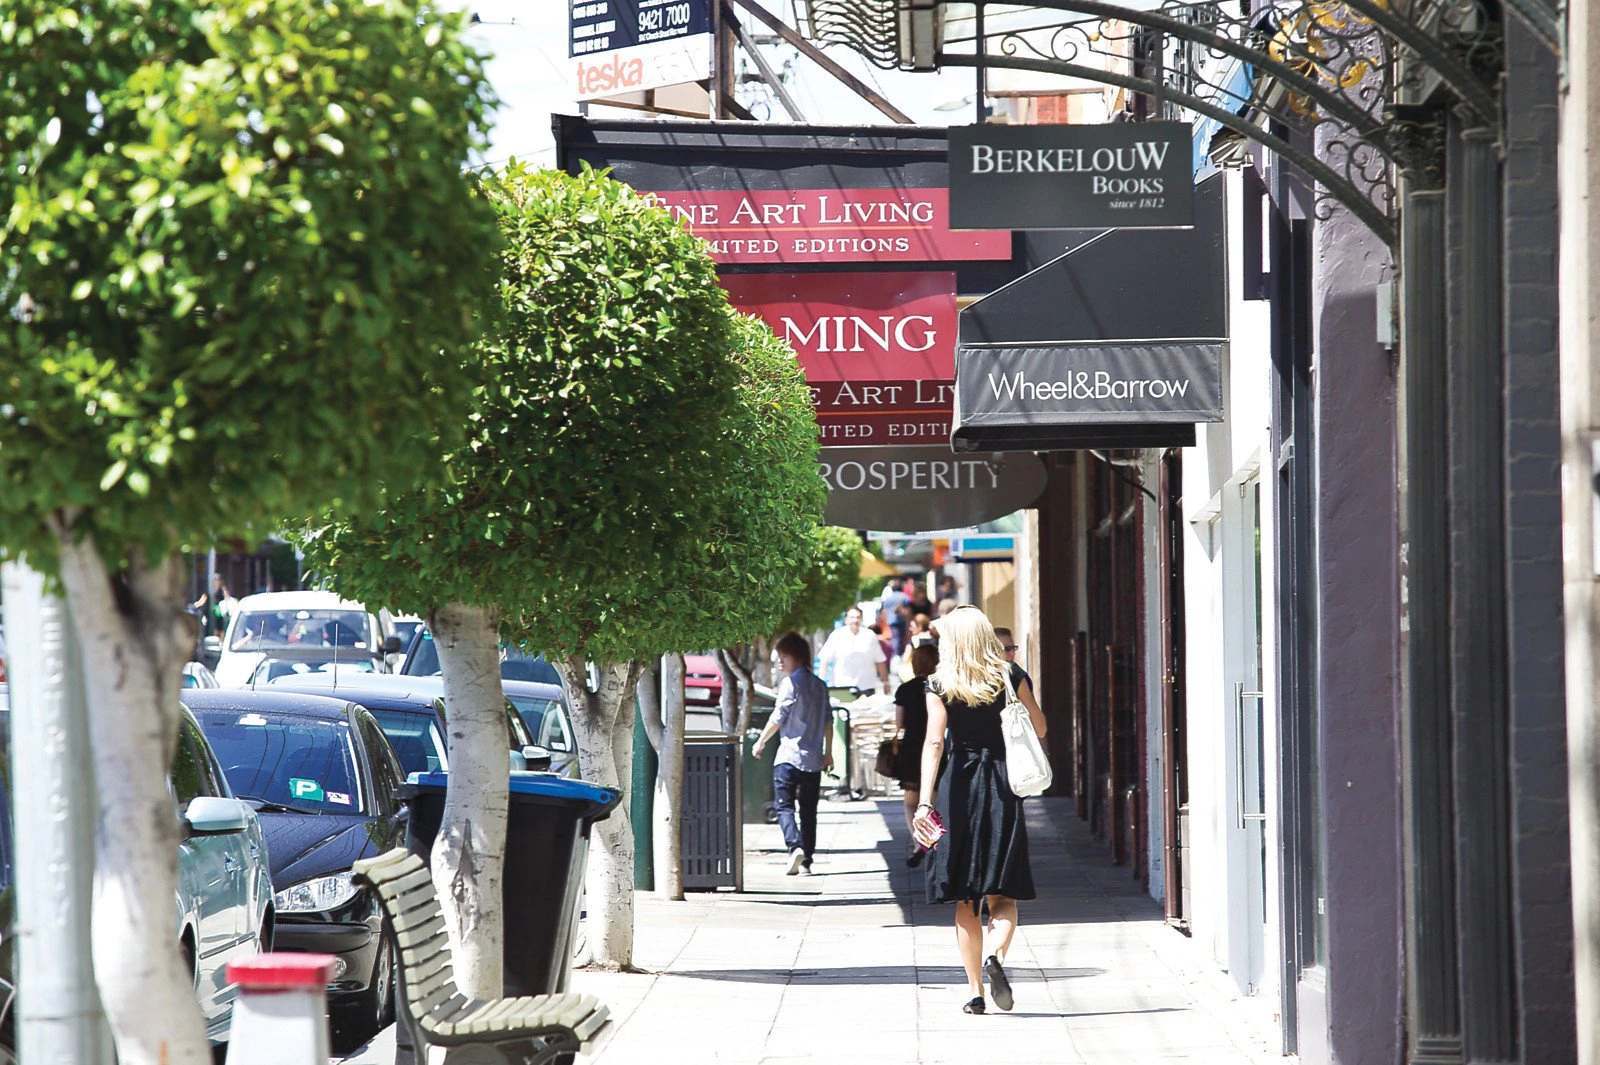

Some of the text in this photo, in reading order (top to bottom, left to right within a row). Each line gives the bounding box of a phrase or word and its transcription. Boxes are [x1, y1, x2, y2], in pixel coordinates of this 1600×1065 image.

[638, 8, 663, 32] 9421
[665, 2, 690, 26] 7000
[576, 53, 644, 95] teska
[970, 141, 1170, 174] BERKELOUW
[1092, 175, 1164, 195] BOOKS
[729, 197, 806, 225] ART
[818, 195, 934, 224] LIVING
[1109, 197, 1165, 209] since 1812
[794, 237, 910, 254] EDITIONS
[832, 380, 902, 405] ART
[987, 370, 1190, 402] Wheel&Barrow
[295, 780, 317, 797] P
